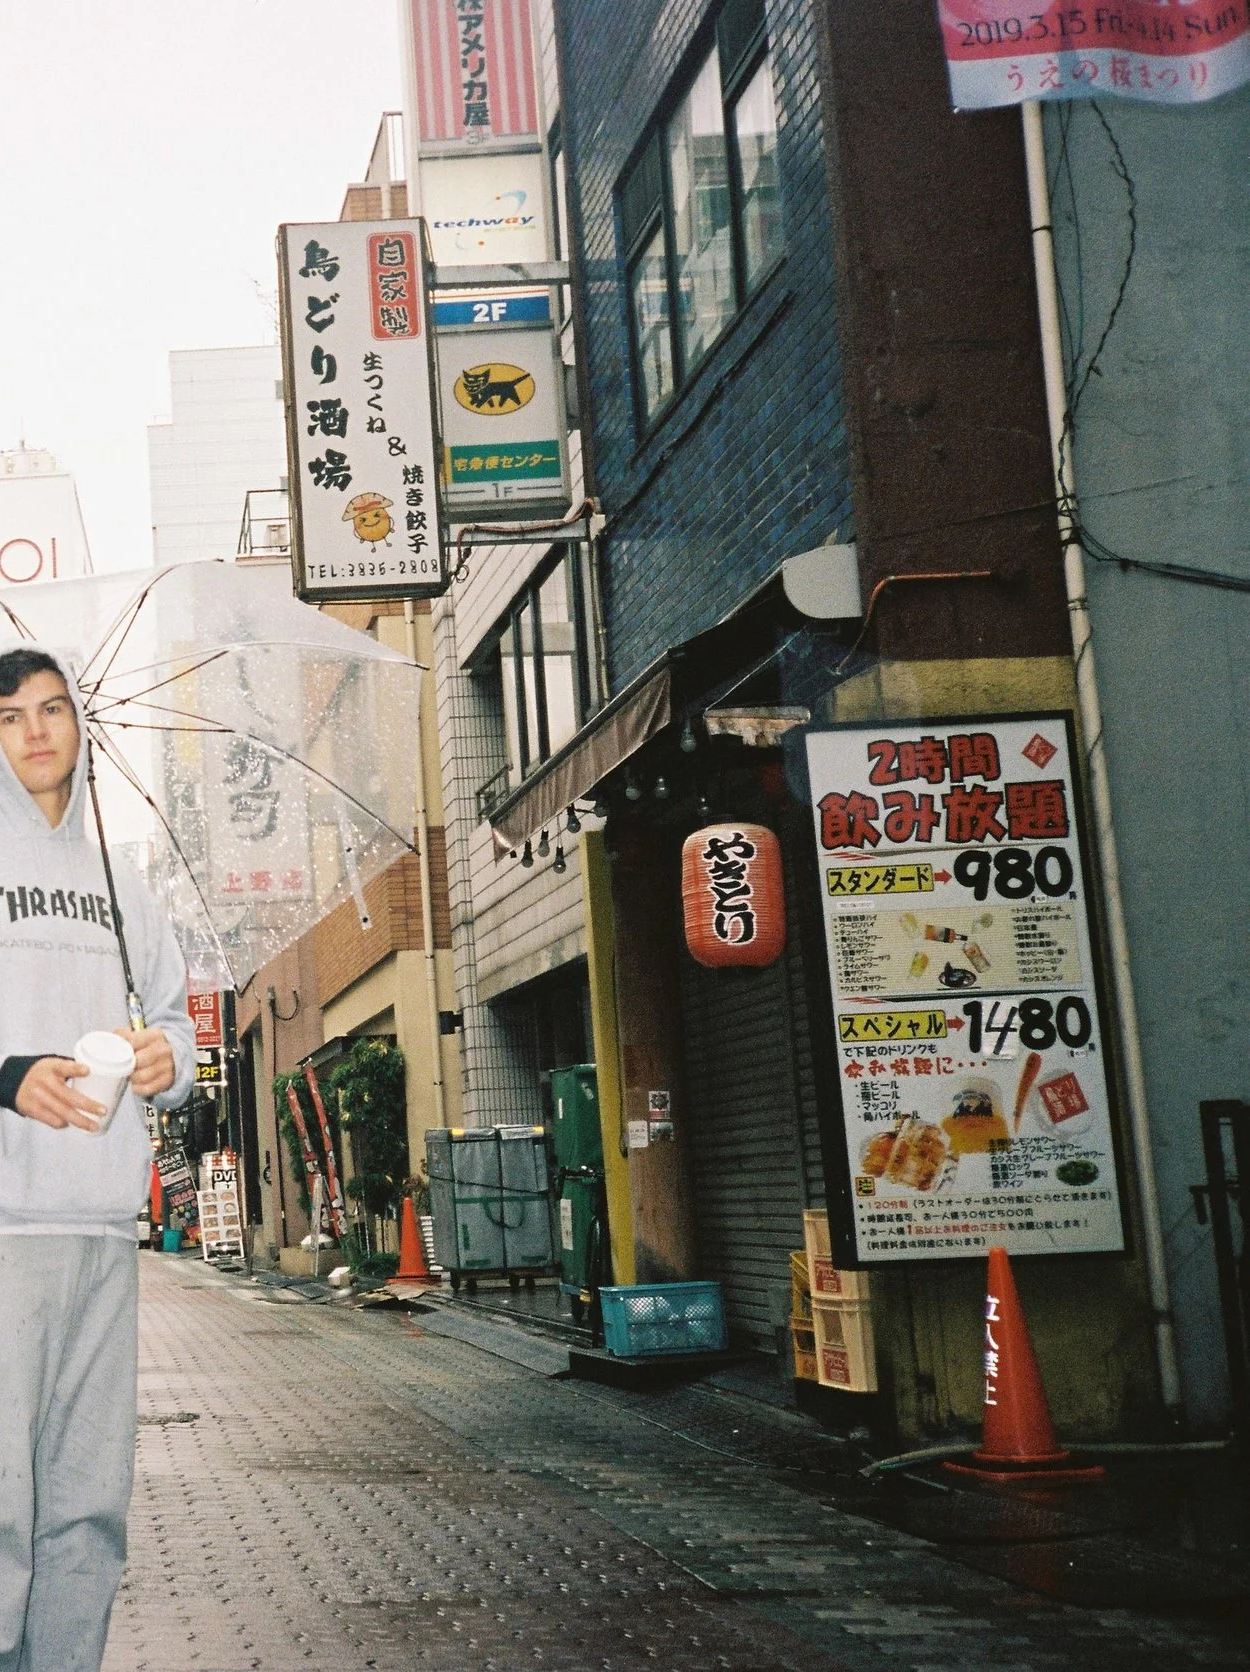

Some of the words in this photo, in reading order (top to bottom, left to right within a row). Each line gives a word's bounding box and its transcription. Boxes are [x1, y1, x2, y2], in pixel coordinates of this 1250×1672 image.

[957, 9, 1086, 46] 2019.3.15
[1185, 6, 1238, 40] Sun
[1006, 55, 1208, 91] うえの桜まつり
[433, 215, 534, 230] techway
[472, 303, 508, 322] 2F
[363, 351, 387, 435] 生つくね
[387, 436, 407, 457] &
[454, 451, 556, 472] 宅急便センター
[402, 464, 429, 553] 焼き餃子
[867, 733, 1002, 786] 2時間
[817, 779, 1070, 850] 飲み放題
[703, 831, 756, 945] やきとり
[829, 866, 930, 893] スタンダード
[953, 847, 1073, 901] 980
[840, 1013, 945, 1040] スペシャル
[963, 995, 1092, 1057] 1480
[842, 1043, 938, 1058] で下記のドリンクも
[860, 1080, 899, 1091] 生ビール
[862, 1101, 897, 1111] マッコリ
